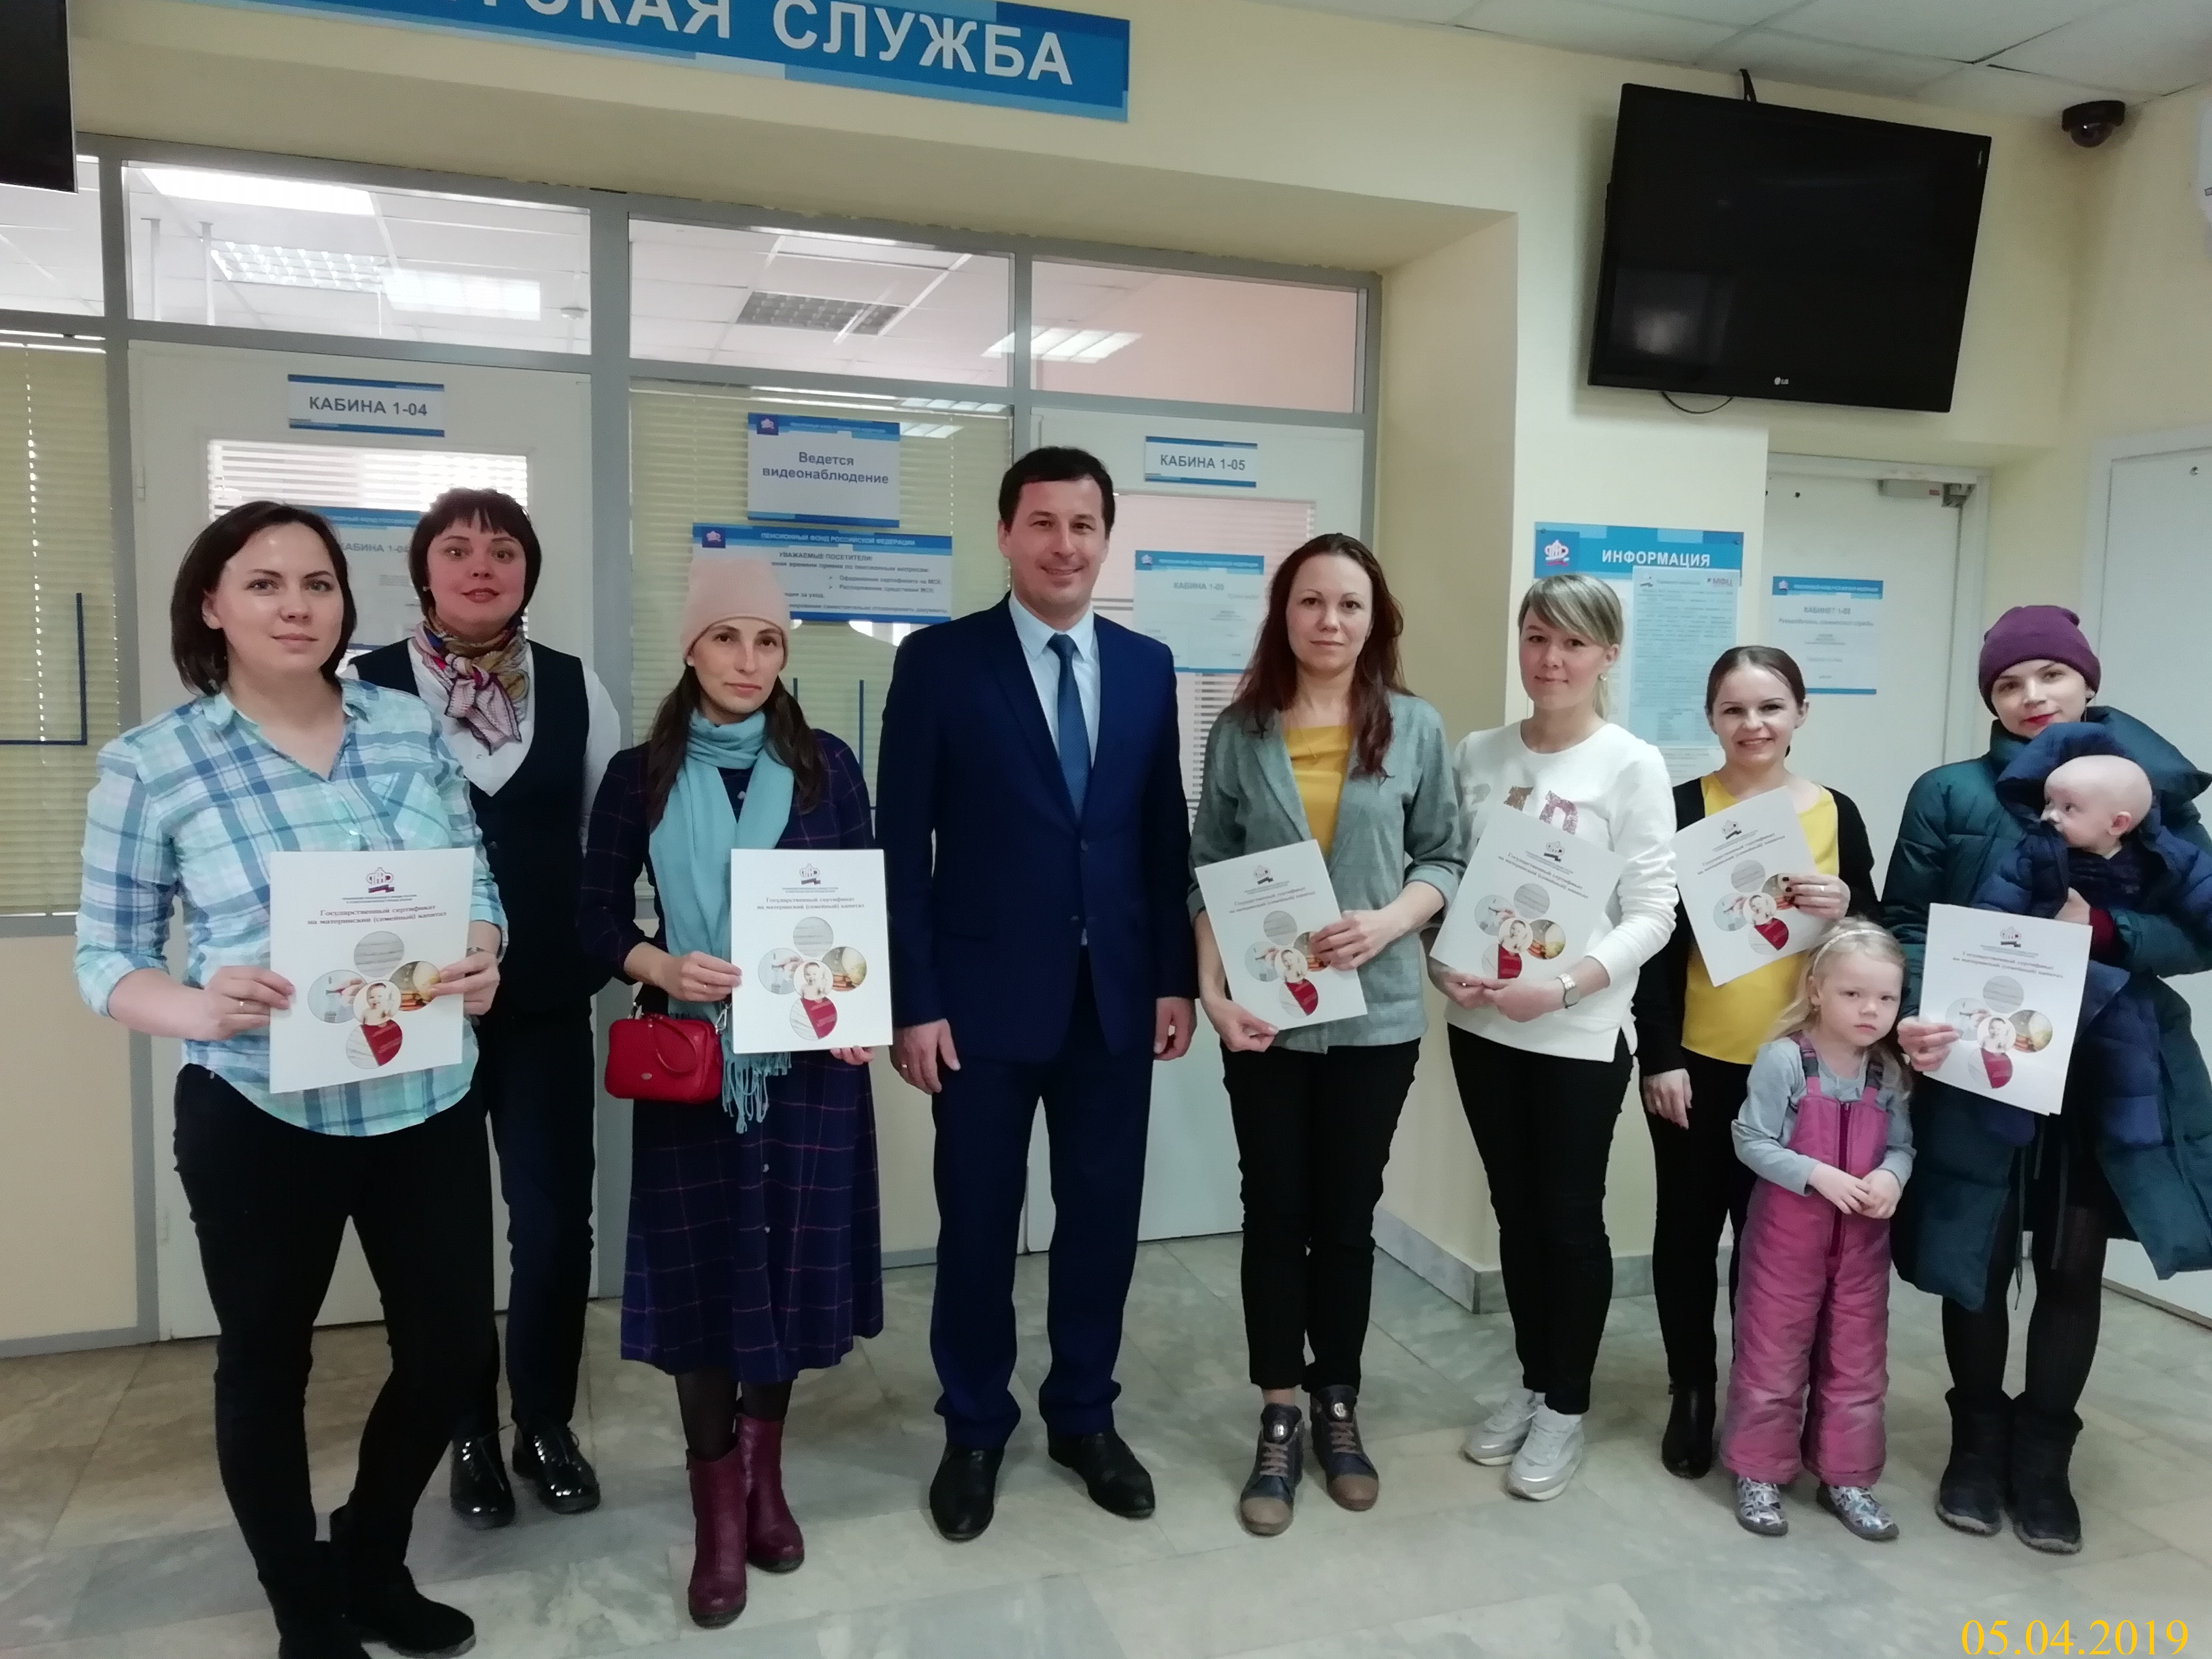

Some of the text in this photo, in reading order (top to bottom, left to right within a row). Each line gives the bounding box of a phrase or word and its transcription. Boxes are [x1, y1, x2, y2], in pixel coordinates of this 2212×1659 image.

[773, 0, 1073, 85] СЛУЖБА
[309, 396, 428, 416] КАБИНА 1-04
[799, 451, 854, 466] Ведется
[1160, 454, 1245, 471] КАБИНА 1-05
[762, 467, 889, 484] видеонаблюдение
[1602, 549, 1711, 568] ИНФОРМАЦИЯ
[320, 907, 390, 917] Государственный
